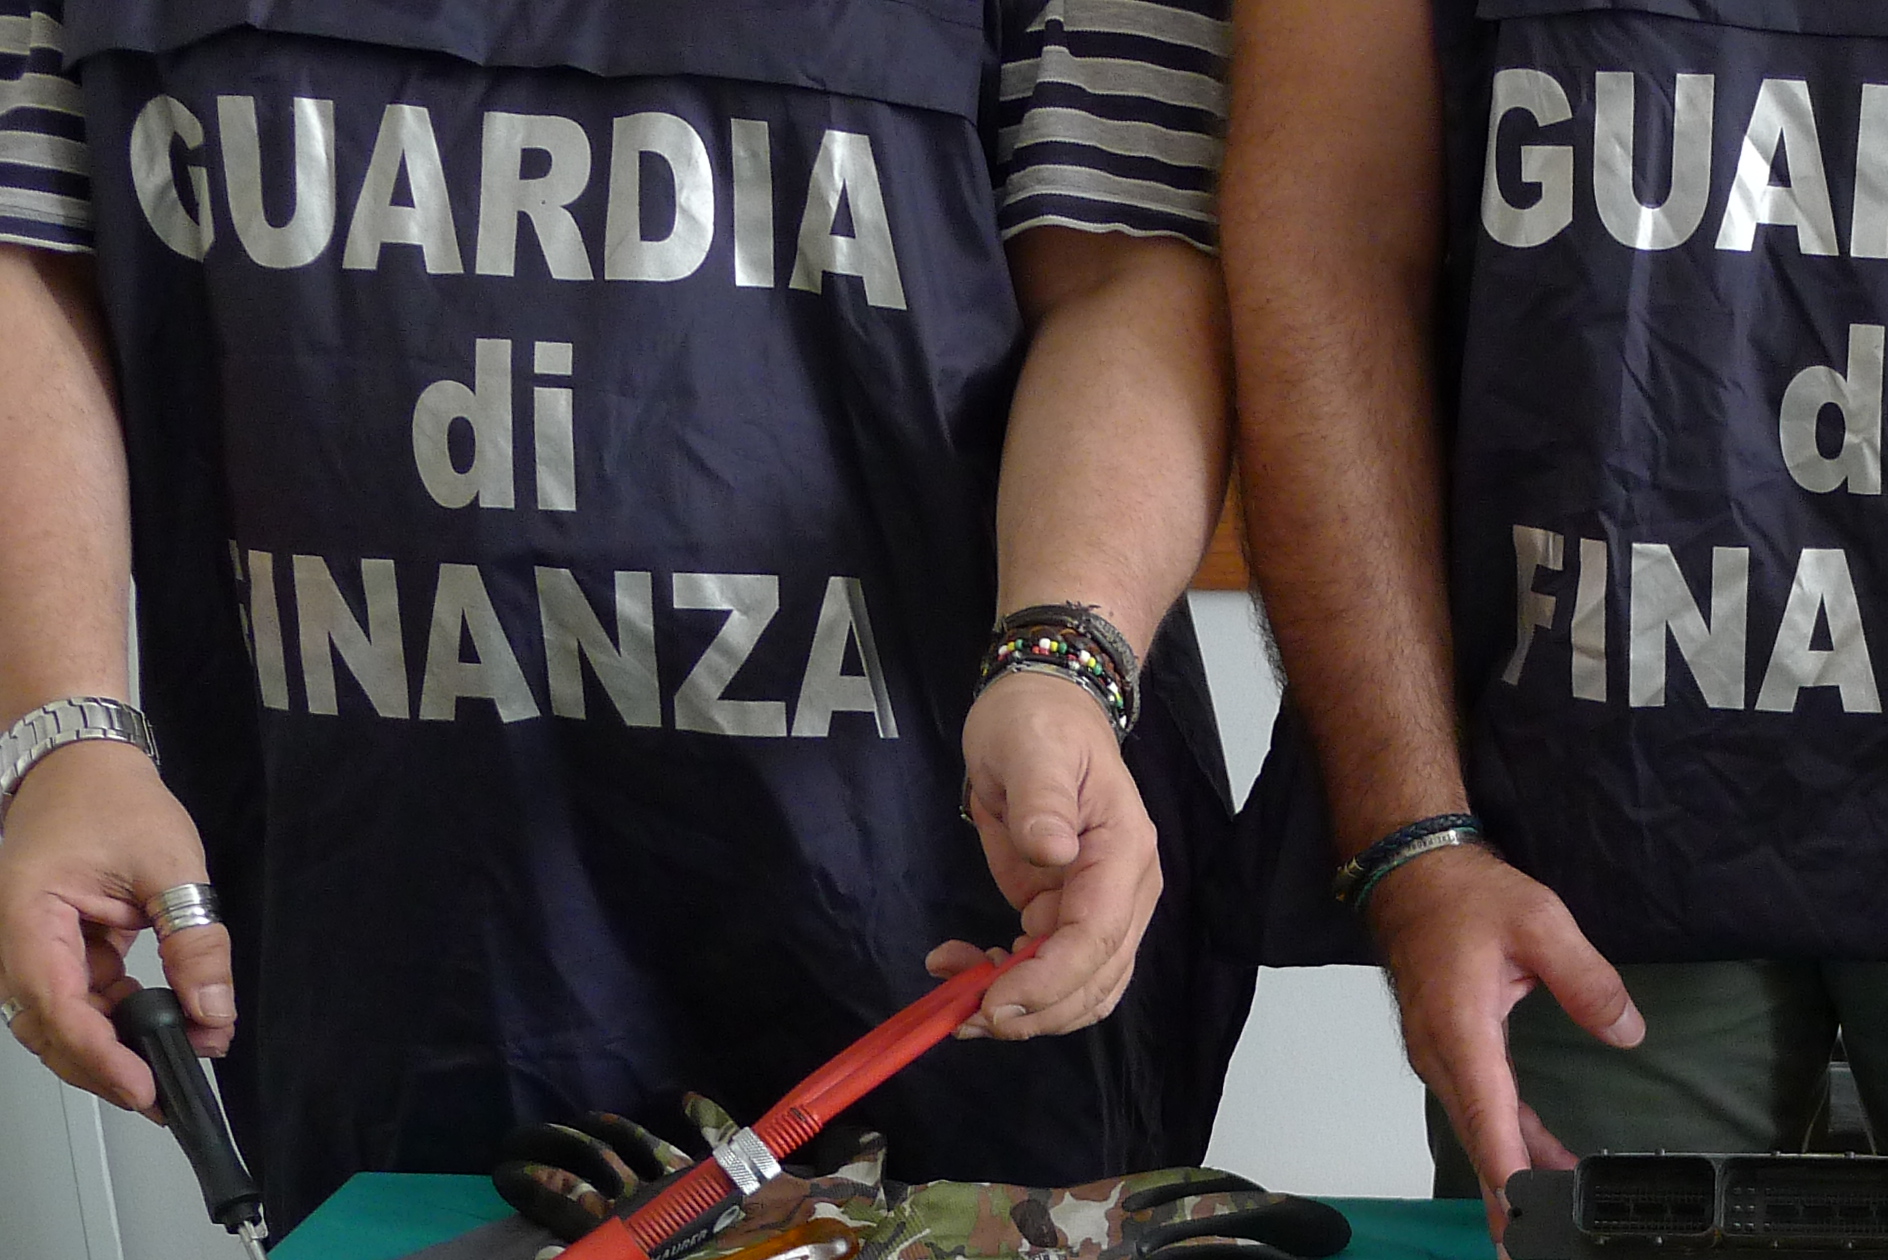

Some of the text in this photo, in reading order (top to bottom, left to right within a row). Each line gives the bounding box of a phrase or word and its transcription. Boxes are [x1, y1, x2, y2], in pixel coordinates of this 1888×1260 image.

[130, 95, 907, 310] GUARDIA
[412, 340, 577, 511] di
[230, 550, 899, 739] INANZA
